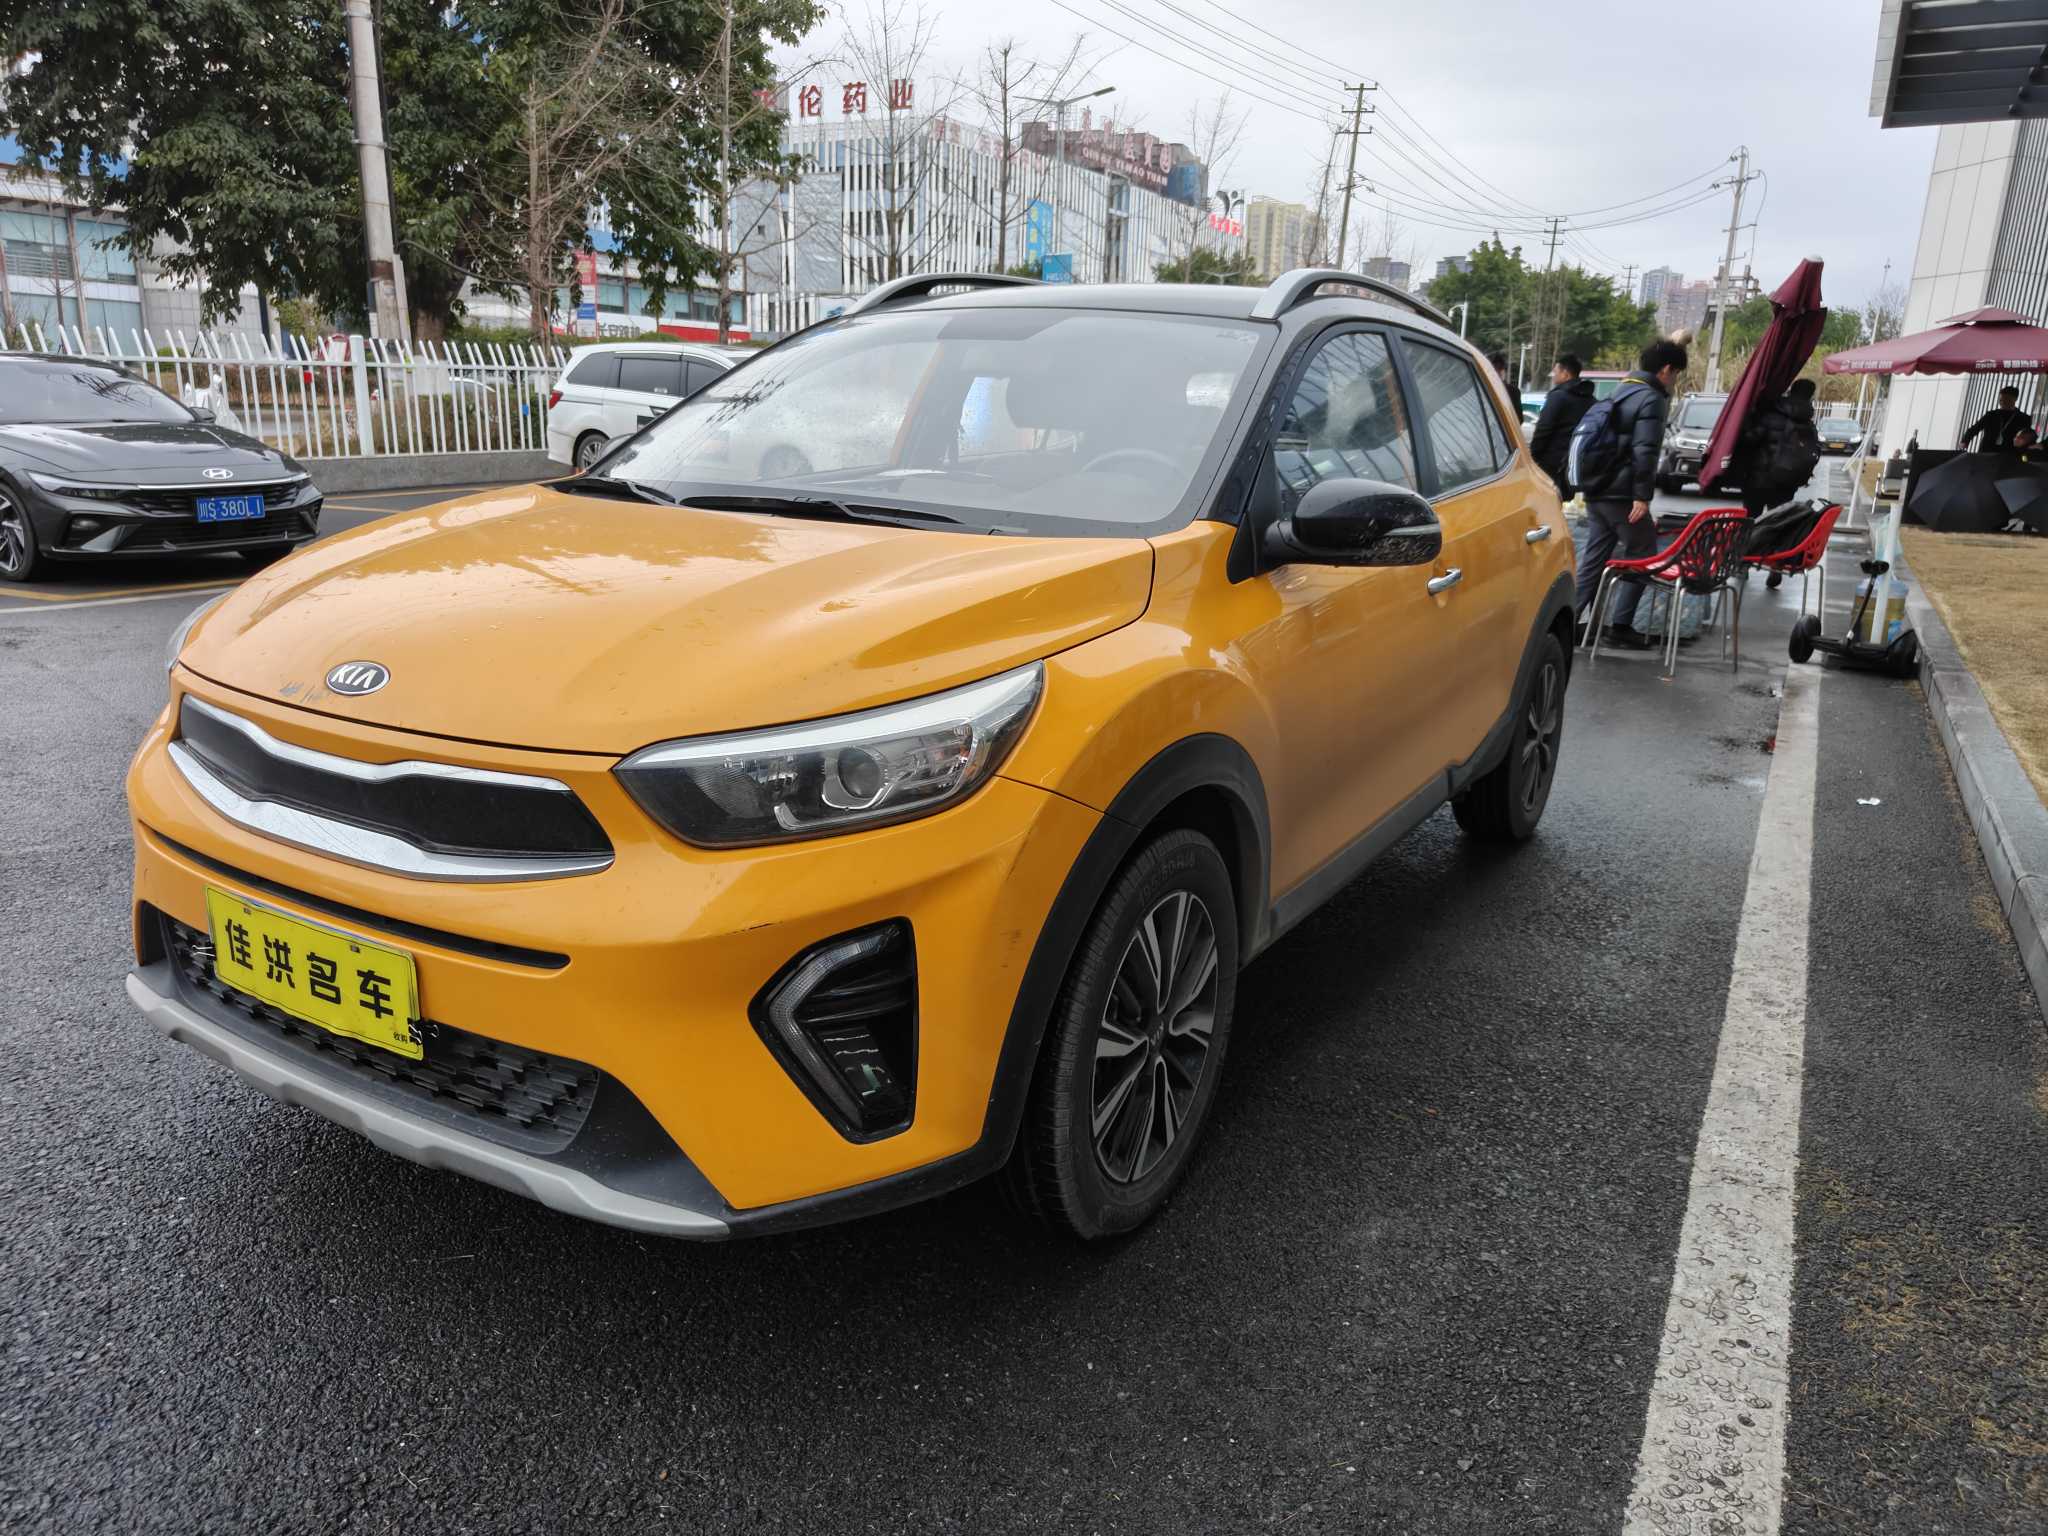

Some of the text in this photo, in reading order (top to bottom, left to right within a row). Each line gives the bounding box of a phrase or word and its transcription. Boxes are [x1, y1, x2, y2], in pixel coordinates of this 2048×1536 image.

[330, 664, 378, 689] KIA
[225, 918, 394, 1019] 佳洪名车
